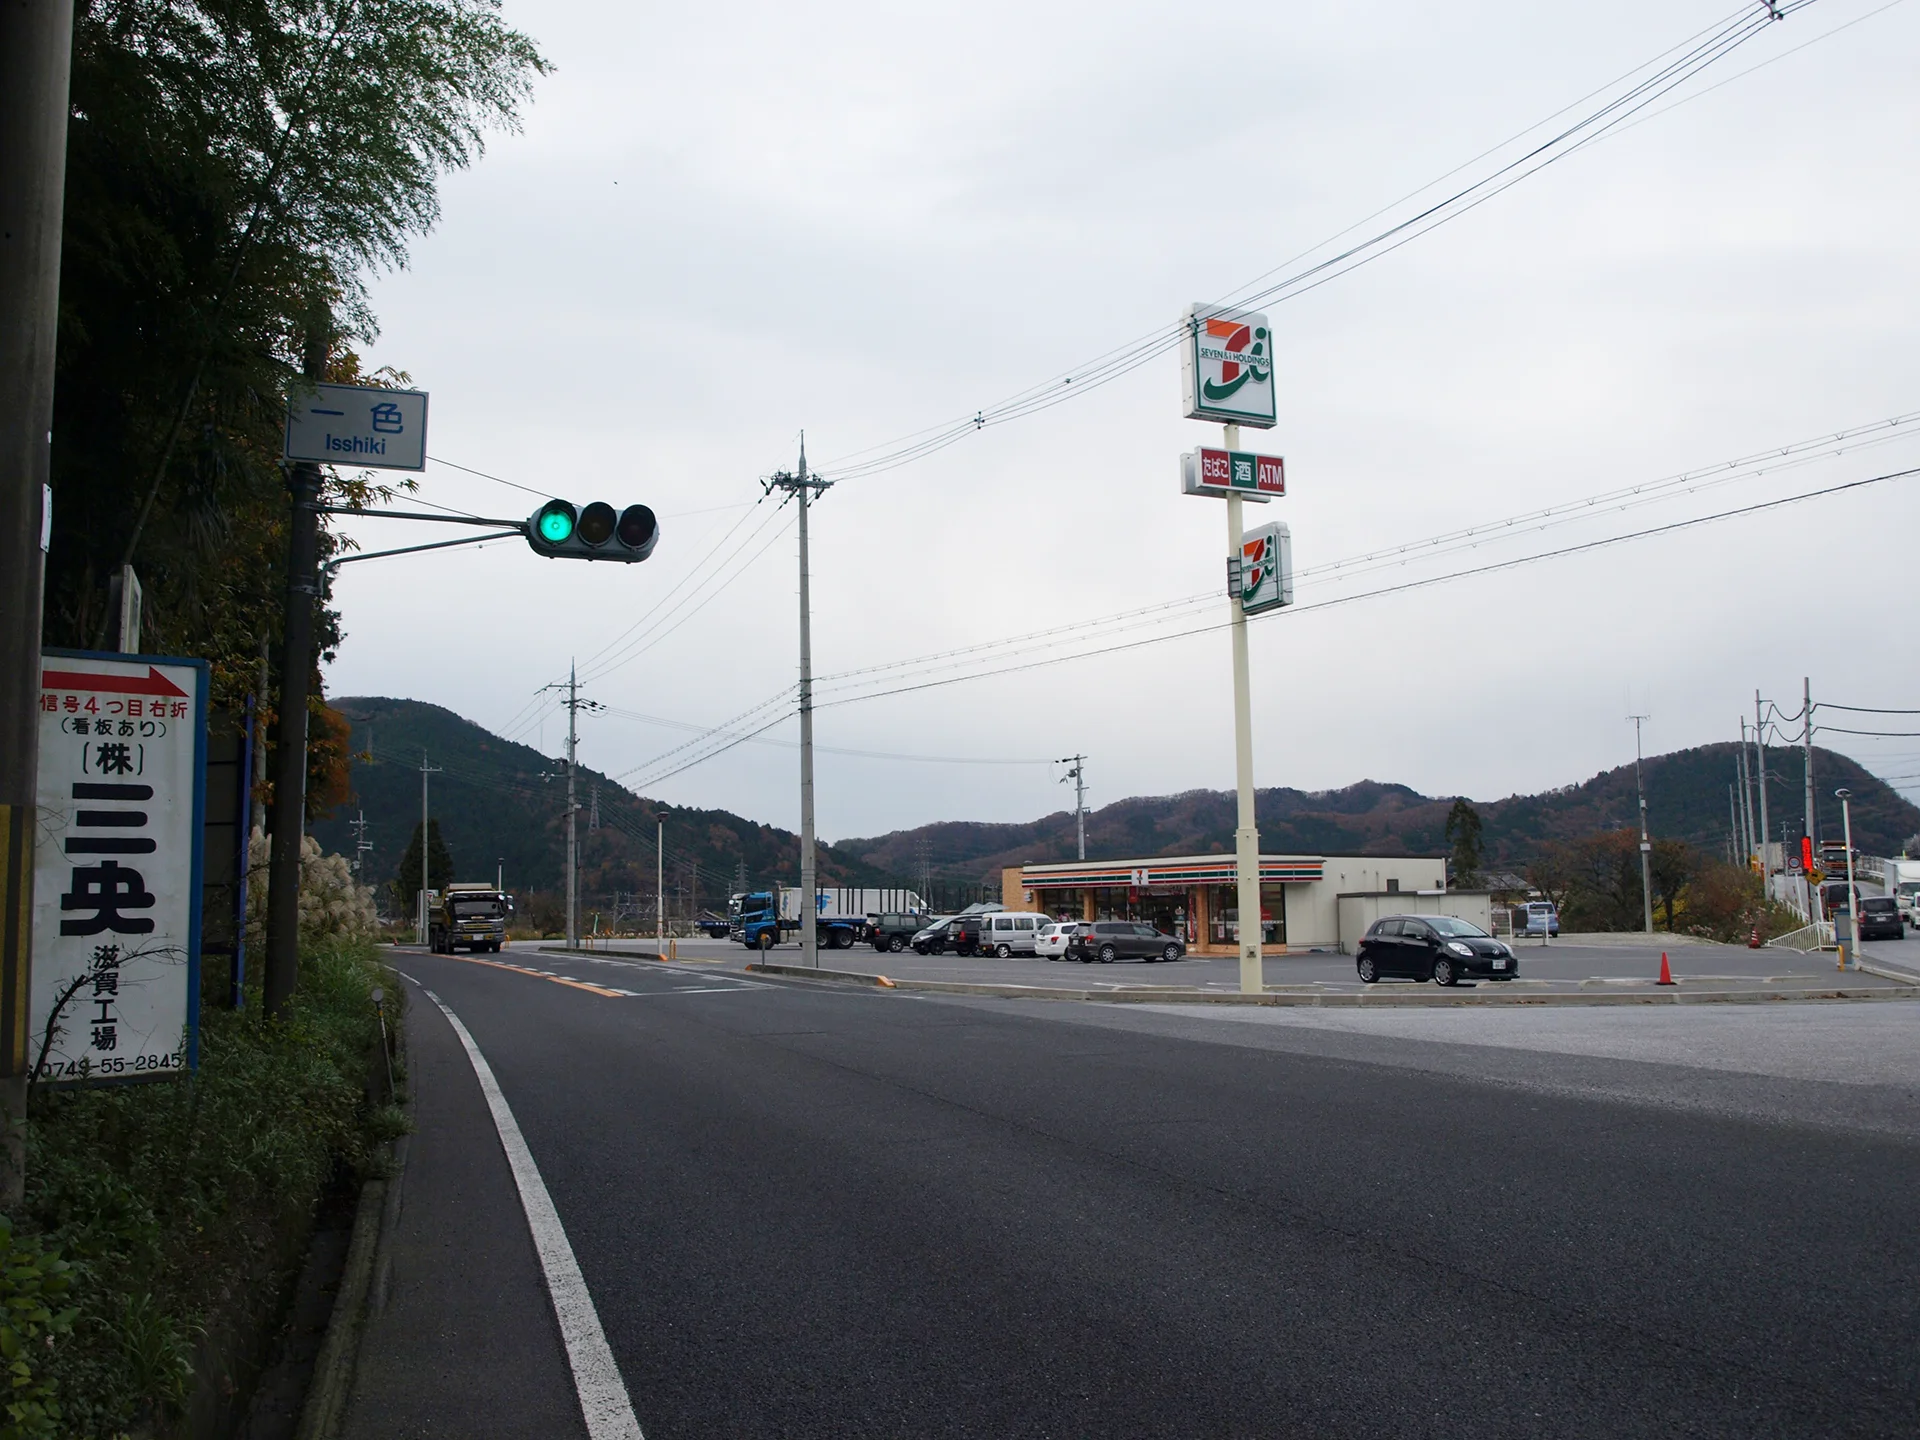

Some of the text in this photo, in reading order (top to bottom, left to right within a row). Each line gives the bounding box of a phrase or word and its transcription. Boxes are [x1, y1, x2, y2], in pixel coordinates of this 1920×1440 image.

[1233, 352, 1270, 367] HOLDINGS
[310, 402, 404, 434] 一色
[326, 433, 386, 455] Isshiki
[1203, 457, 1283, 485] たばこ 酒 ATM
[39, 694, 188, 719] 信号4つ目右折
[60, 782, 157, 936] 三央
[90, 944, 120, 1051] 滋賀工場
